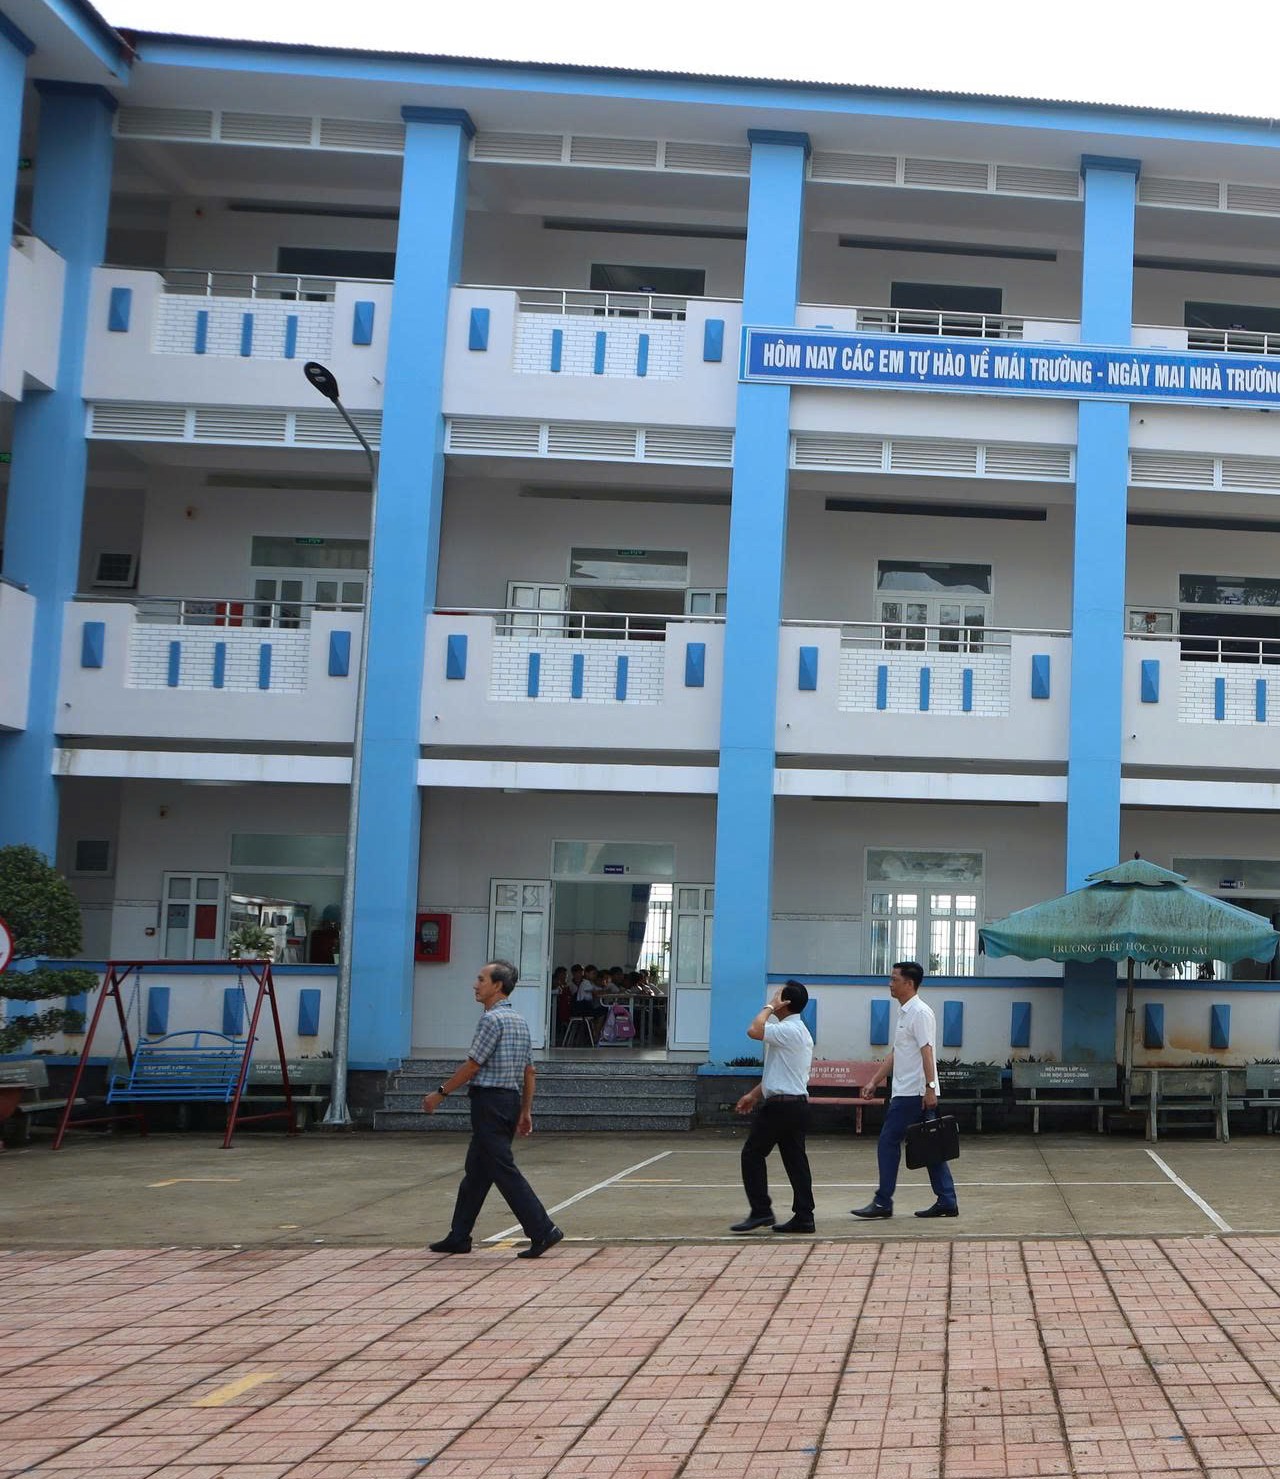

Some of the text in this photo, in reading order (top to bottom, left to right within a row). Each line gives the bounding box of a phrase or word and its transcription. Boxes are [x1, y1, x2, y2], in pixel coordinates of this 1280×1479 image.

[763, 340, 800, 368] HÔM
[806, 345, 836, 370] NAY
[842, 343, 874, 372] CÁC
[879, 350, 904, 374] EM
[909, 351, 930, 379] TỰ
[933, 348, 965, 377] HÀO
[970, 347, 990, 378] VỀ
[994, 352, 1025, 380] MÁI
[1029, 354, 1093, 384] TRƯỜNG
[1108, 361, 1150, 388] NGÀY
[1155, 365, 1185, 389] MAI
[1190, 363, 1222, 391] NHÀ
